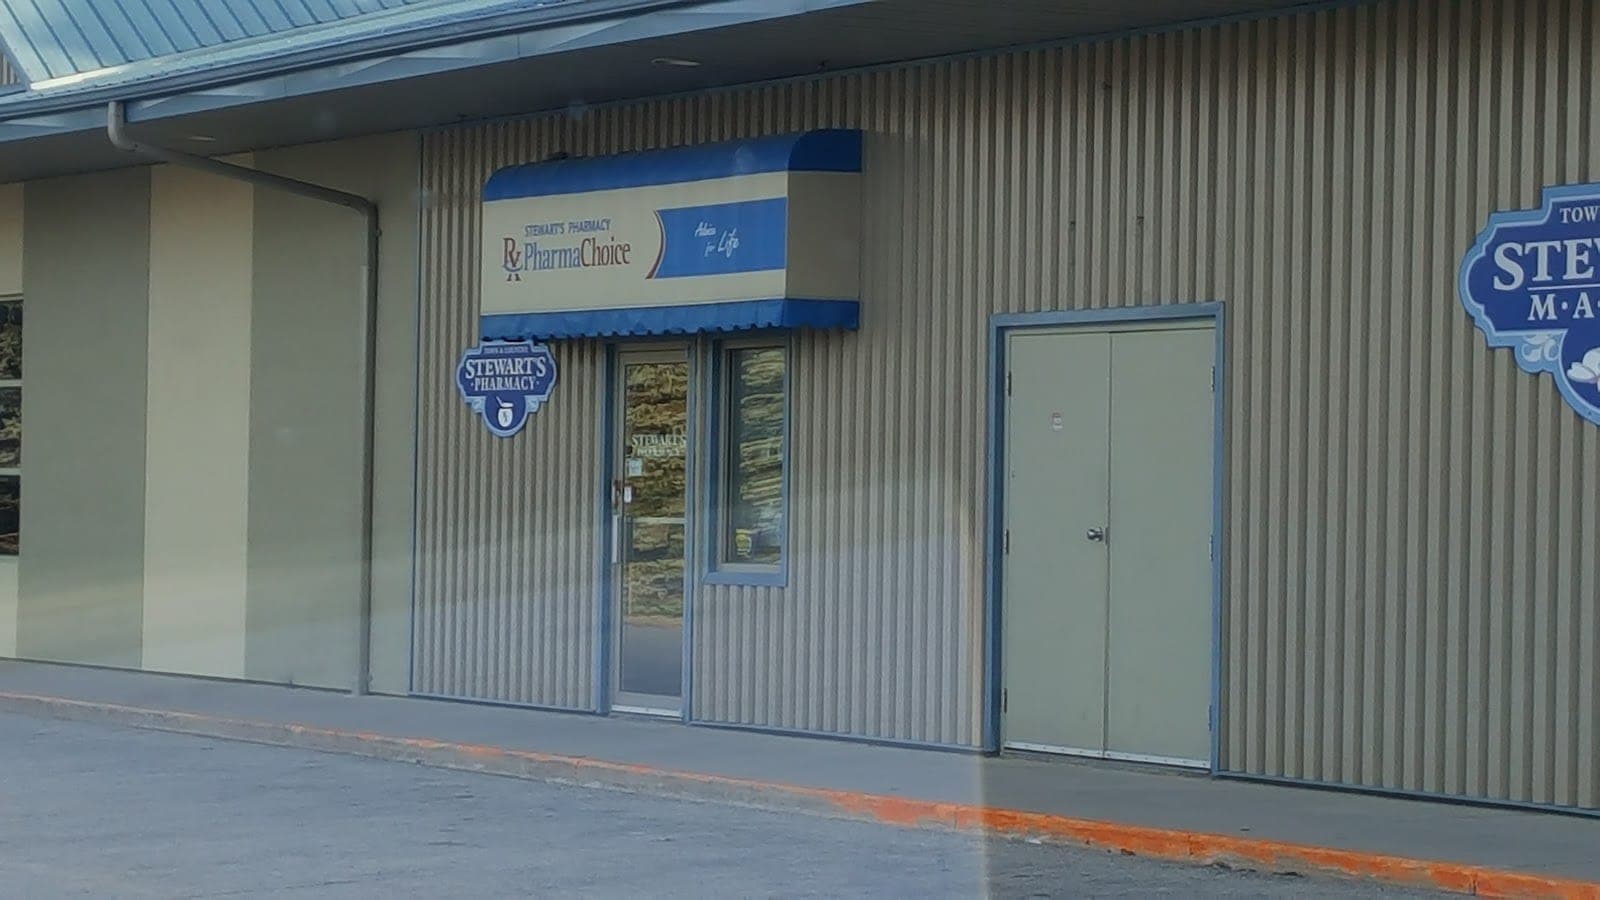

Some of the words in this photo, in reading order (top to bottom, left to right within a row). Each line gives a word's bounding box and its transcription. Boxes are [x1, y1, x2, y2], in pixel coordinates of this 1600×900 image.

[568, 218, 611, 233] PHARMACY
[524, 236, 631, 271] PharmaChoice
[1493, 238, 1600, 291] STE
[465, 356, 546, 379] STEWART'S
[474, 376, 536, 391] PHARMACY
